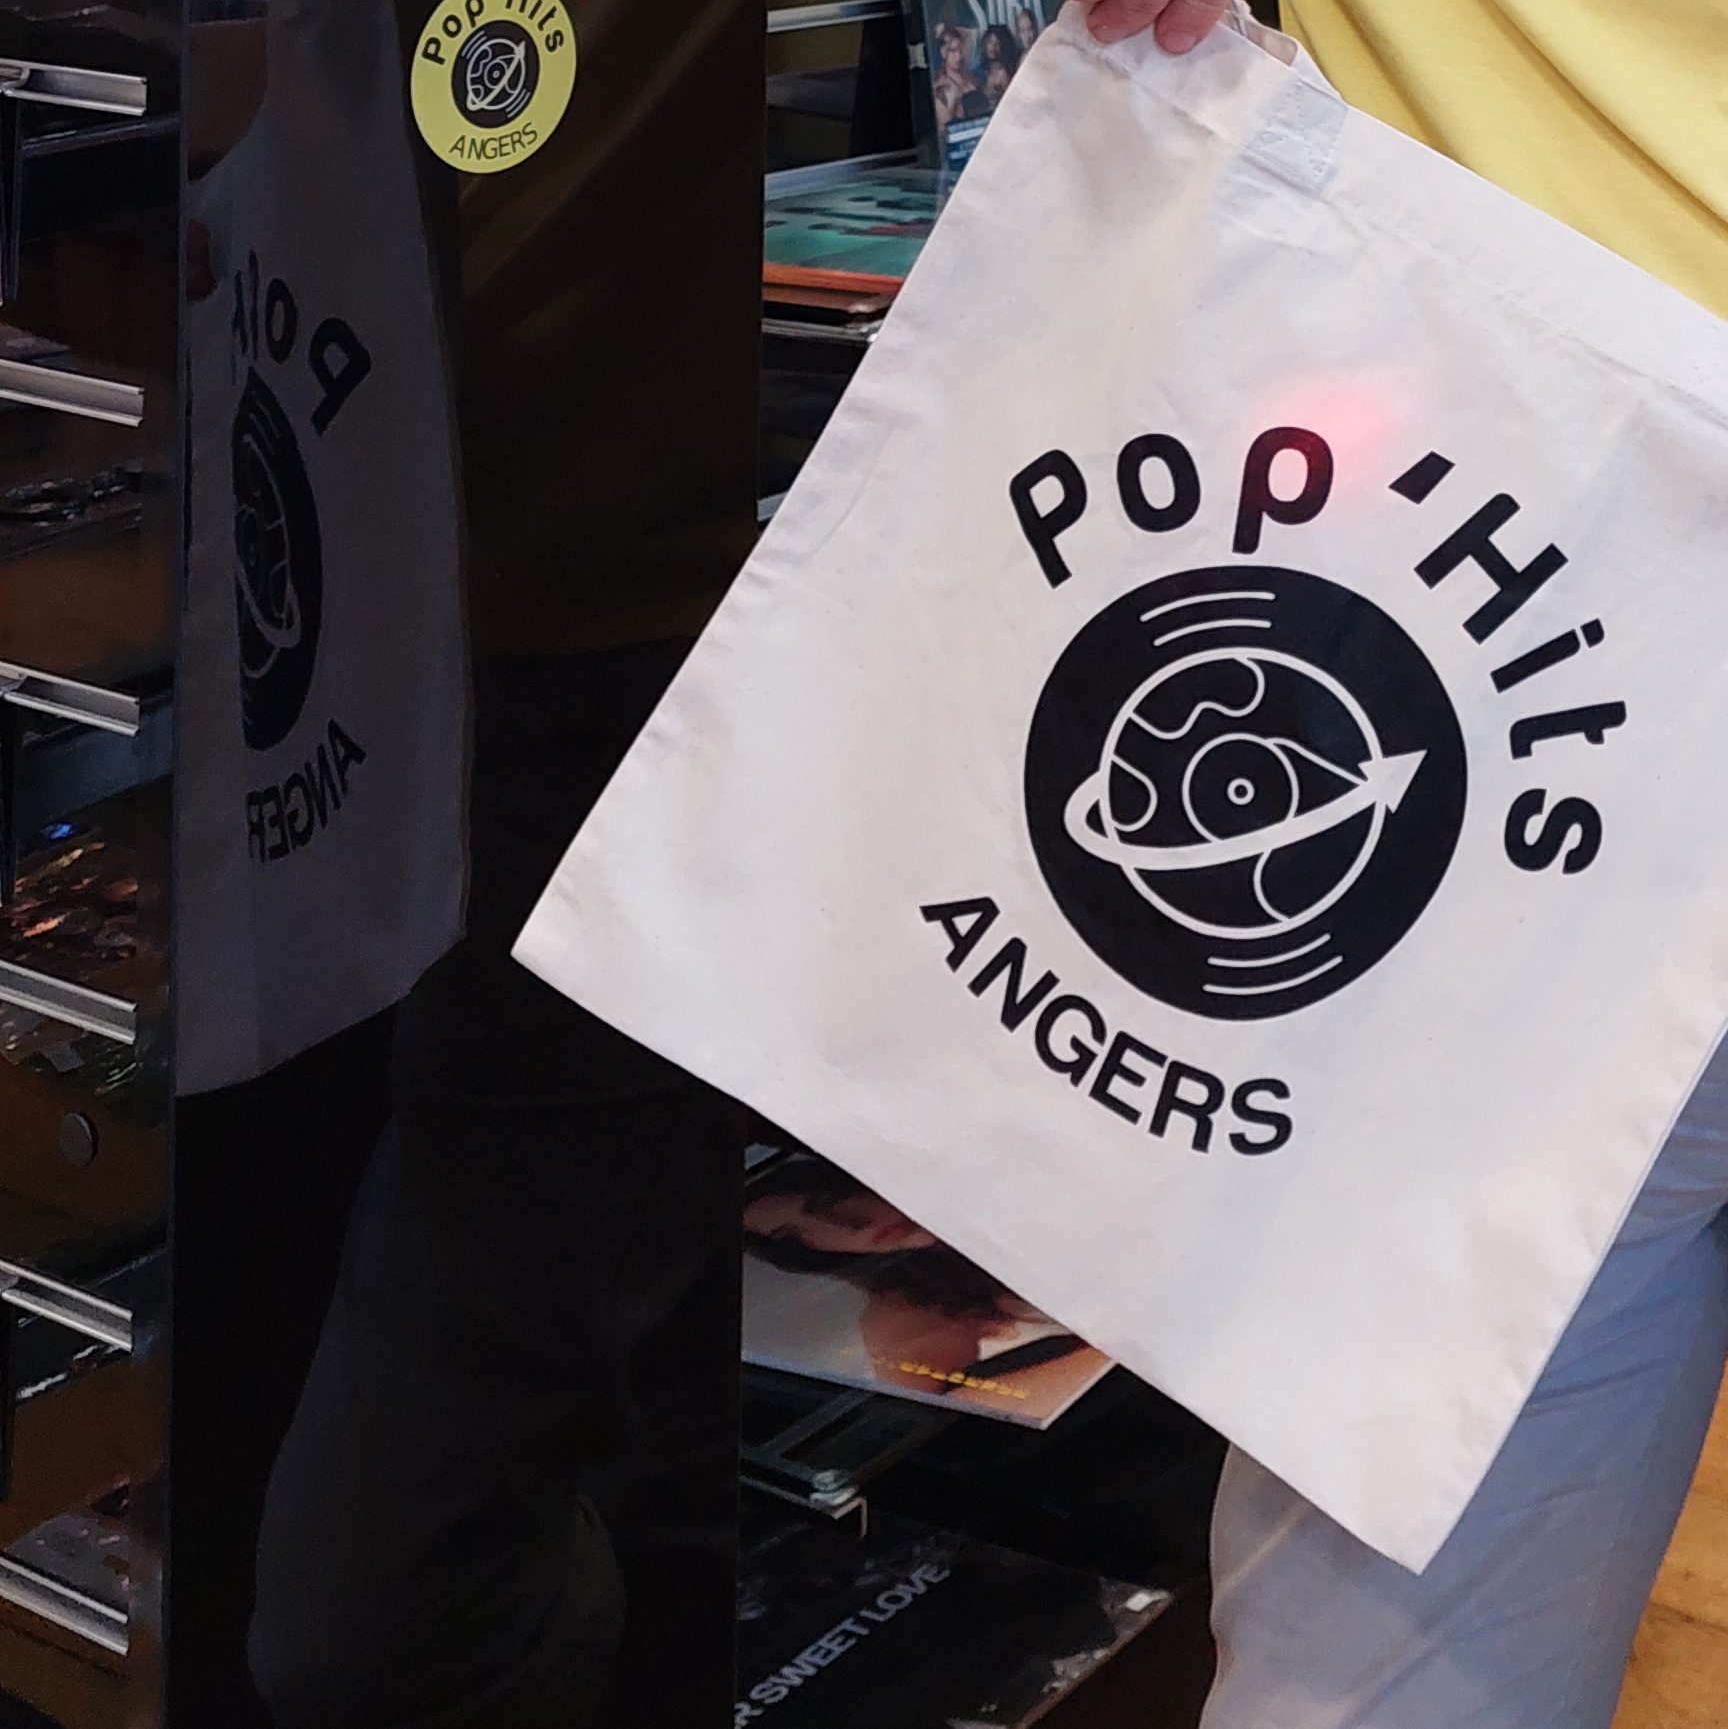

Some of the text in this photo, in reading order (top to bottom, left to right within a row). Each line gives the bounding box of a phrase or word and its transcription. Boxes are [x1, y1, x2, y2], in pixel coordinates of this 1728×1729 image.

[449, 122, 538, 160] ANGERS
[919, 895, 1293, 1156] ANGERS
[749, 1617, 870, 1704] SWEET
[859, 1562, 951, 1622] LOVE
